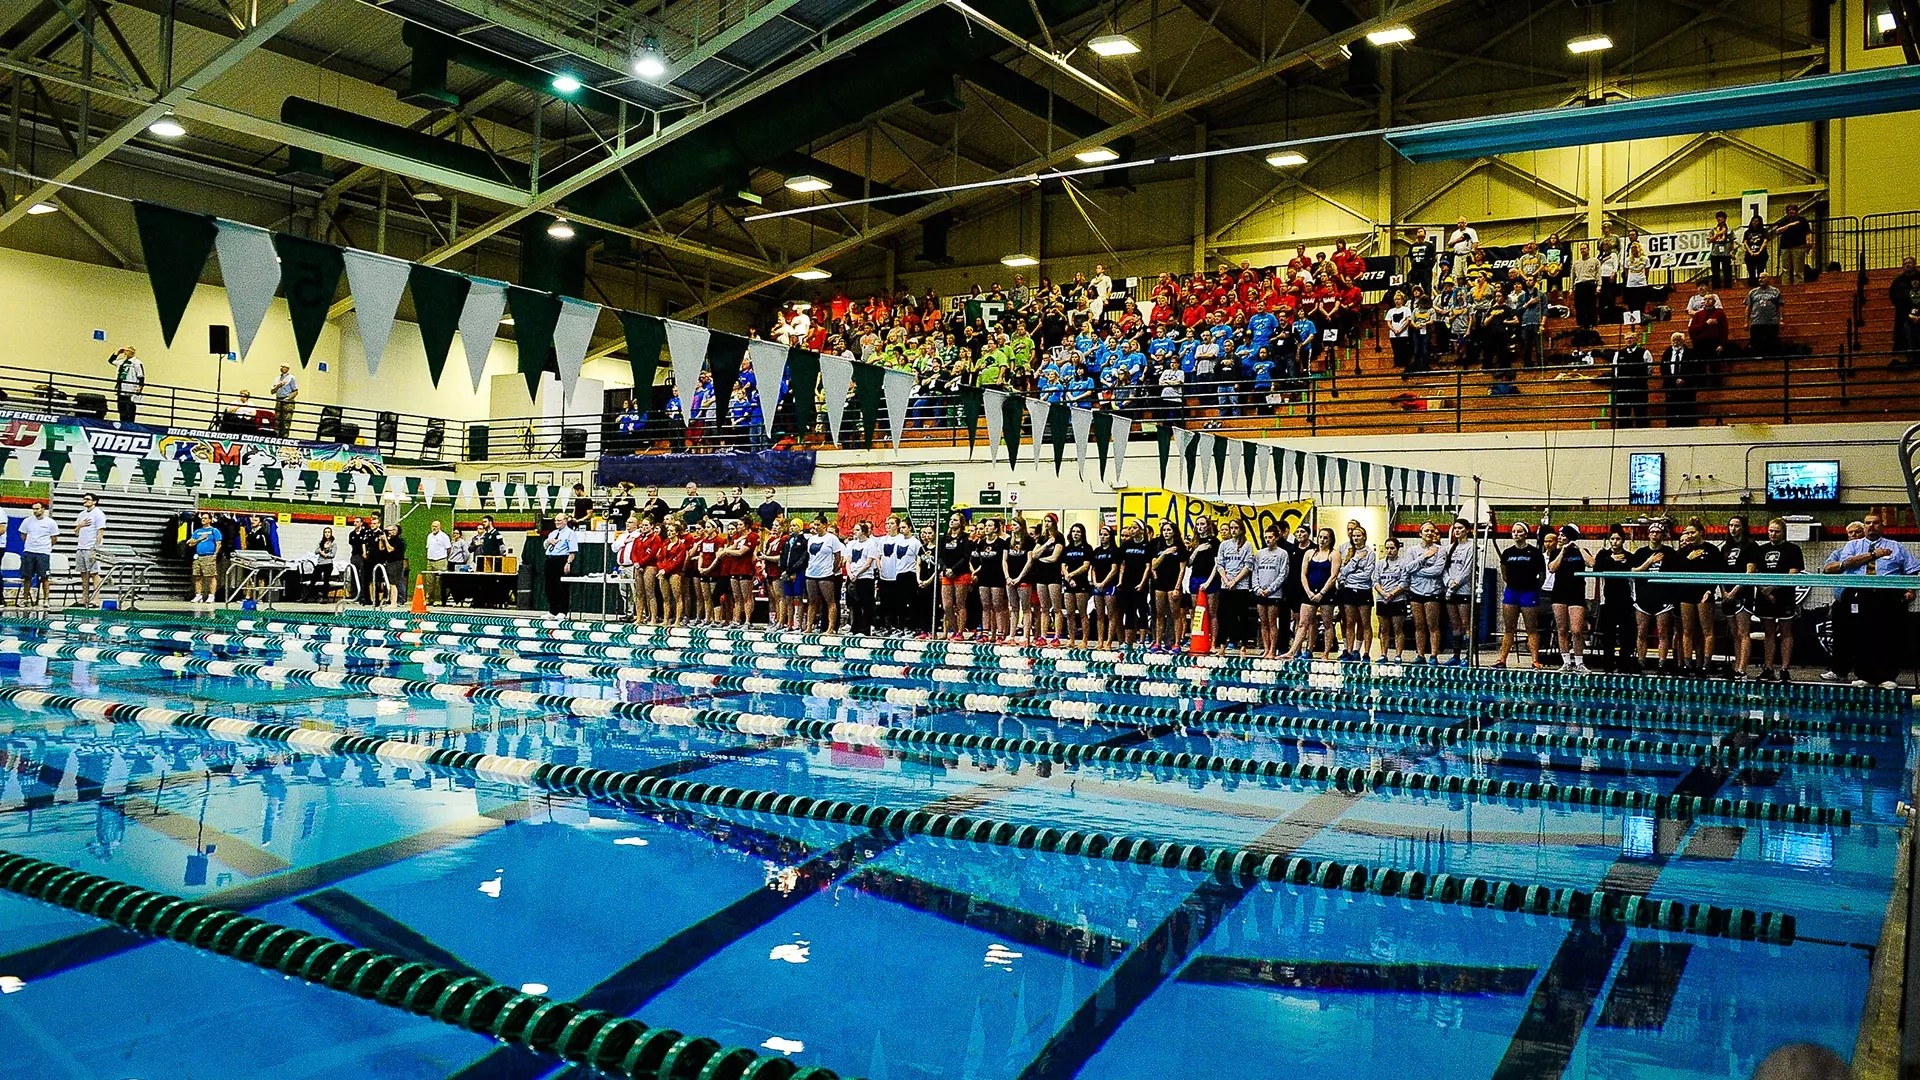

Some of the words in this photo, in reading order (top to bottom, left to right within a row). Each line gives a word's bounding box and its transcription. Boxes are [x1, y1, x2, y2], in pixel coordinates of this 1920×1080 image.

[1649, 235, 1678, 252] GET
[0, 410, 60, 423] NFERENCE
[90, 432, 150, 453] MAC
[167, 427, 240, 440] MID-AMERICAN
[241, 434, 300, 446] CONFERENCE
[1120, 491, 1205, 541] FEAR
